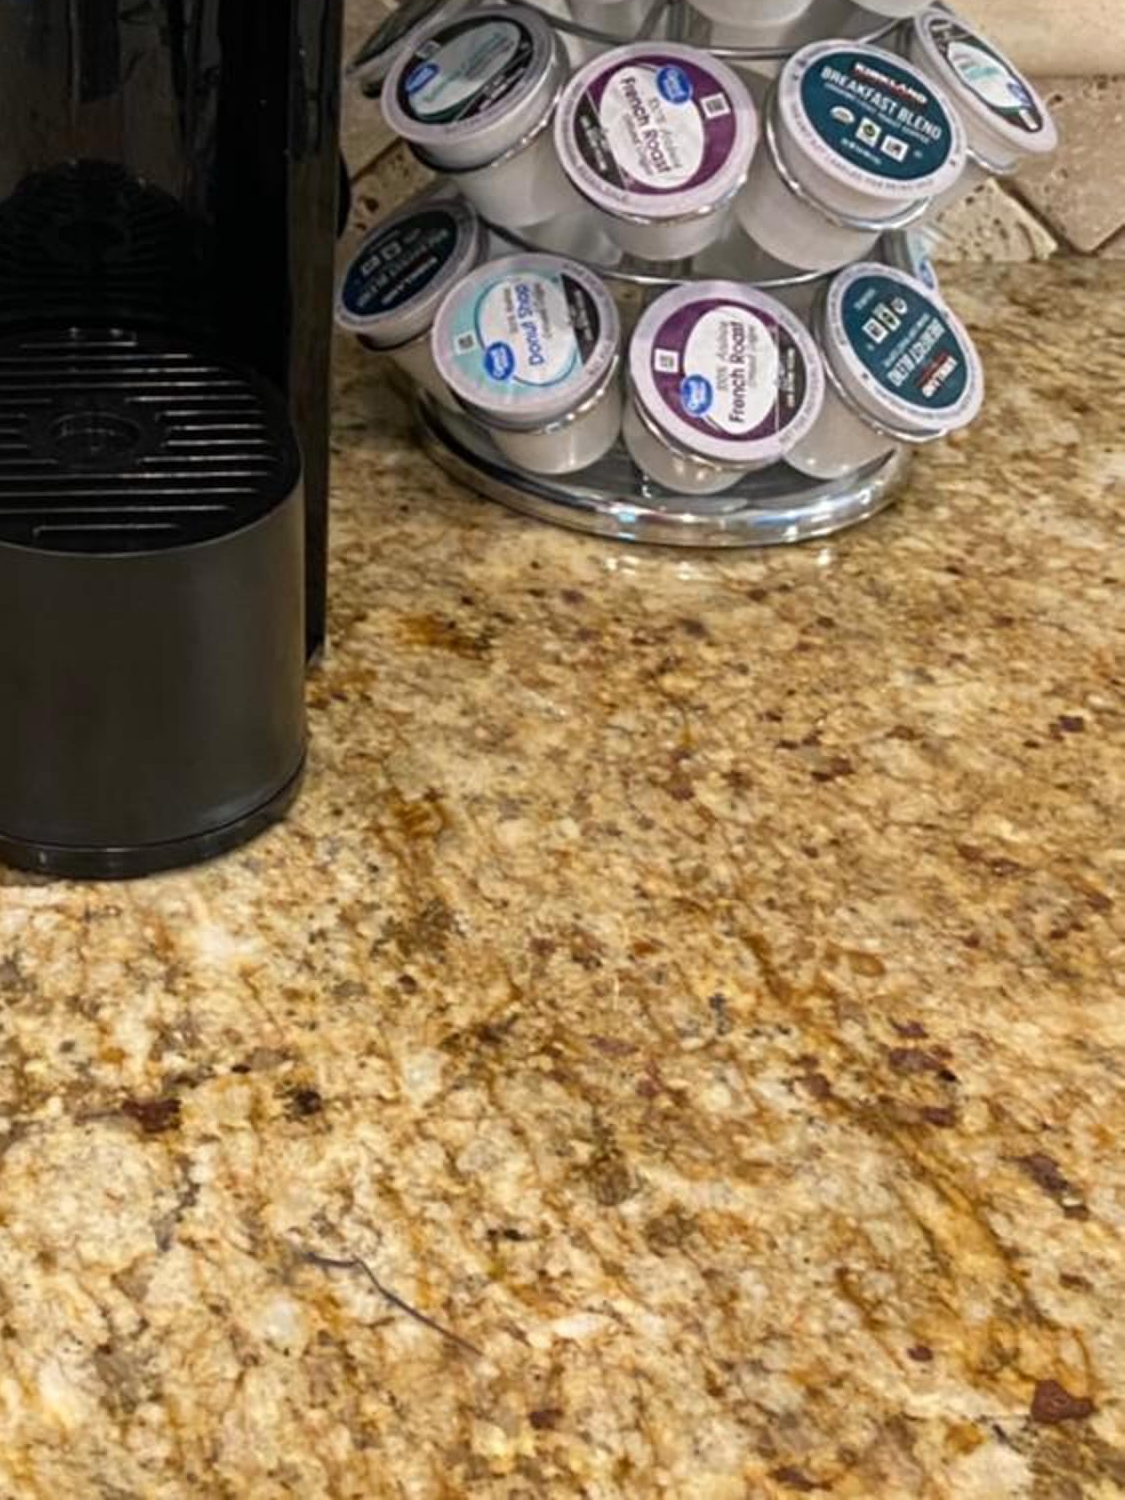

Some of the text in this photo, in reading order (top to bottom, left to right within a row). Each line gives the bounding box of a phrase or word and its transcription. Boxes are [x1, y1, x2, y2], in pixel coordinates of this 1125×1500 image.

[620, 75, 651, 127] French
[641, 129, 672, 174] Roast
[820, 66, 897, 115] BREAKFAST
[896, 105, 943, 141] BLEND
[515, 283, 533, 319] Shop
[521, 320, 545, 366] Donut
[729, 321, 744, 422] French Roast
